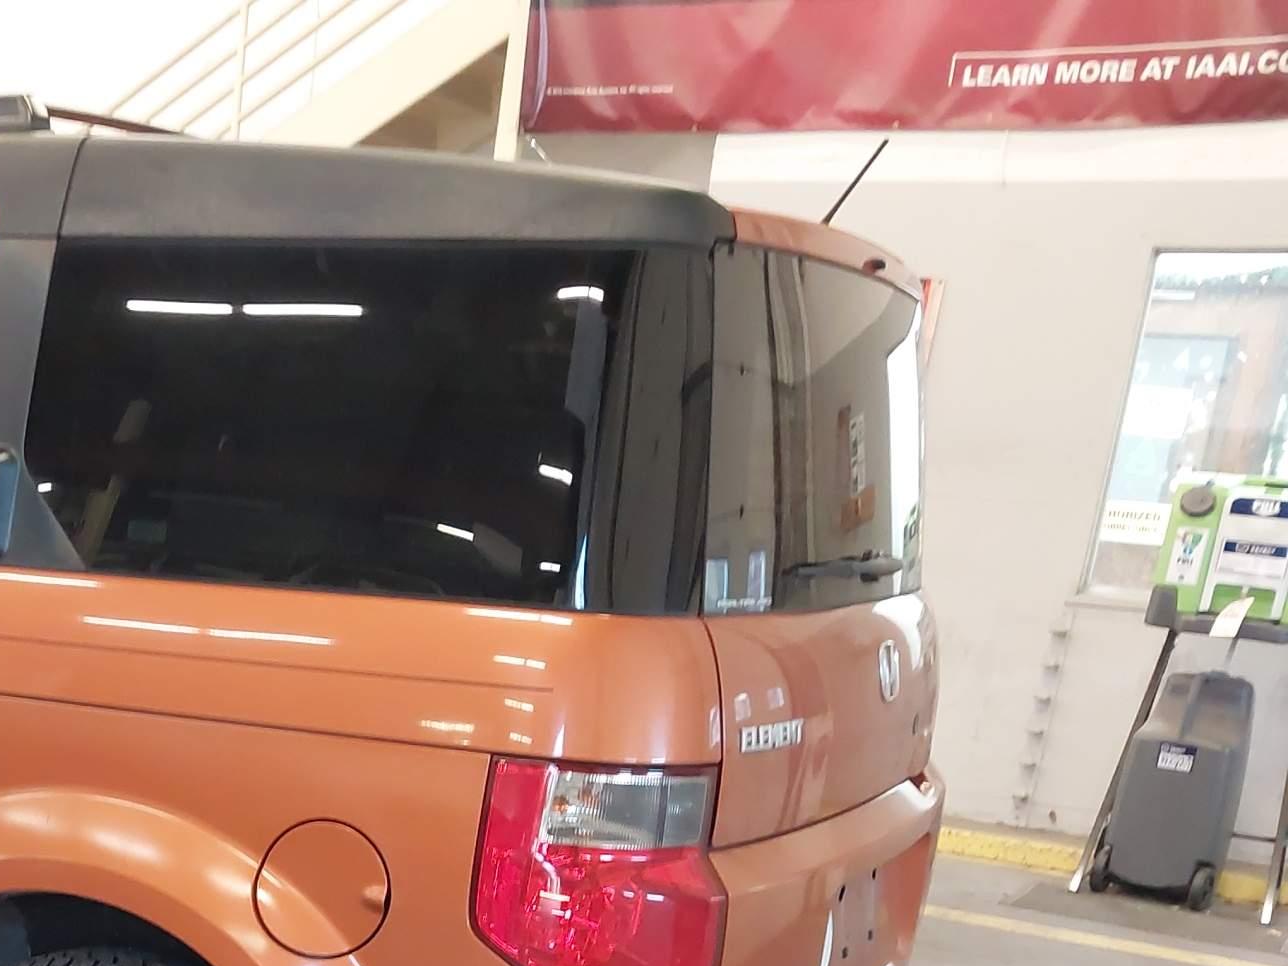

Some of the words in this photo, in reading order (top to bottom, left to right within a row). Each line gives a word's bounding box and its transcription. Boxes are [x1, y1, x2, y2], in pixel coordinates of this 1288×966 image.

[962, 62, 1049, 87] LEARN
[1054, 58, 1138, 85] MORE
[1140, 56, 1182, 82] AT
[740, 718, 804, 753] ELEMENT
